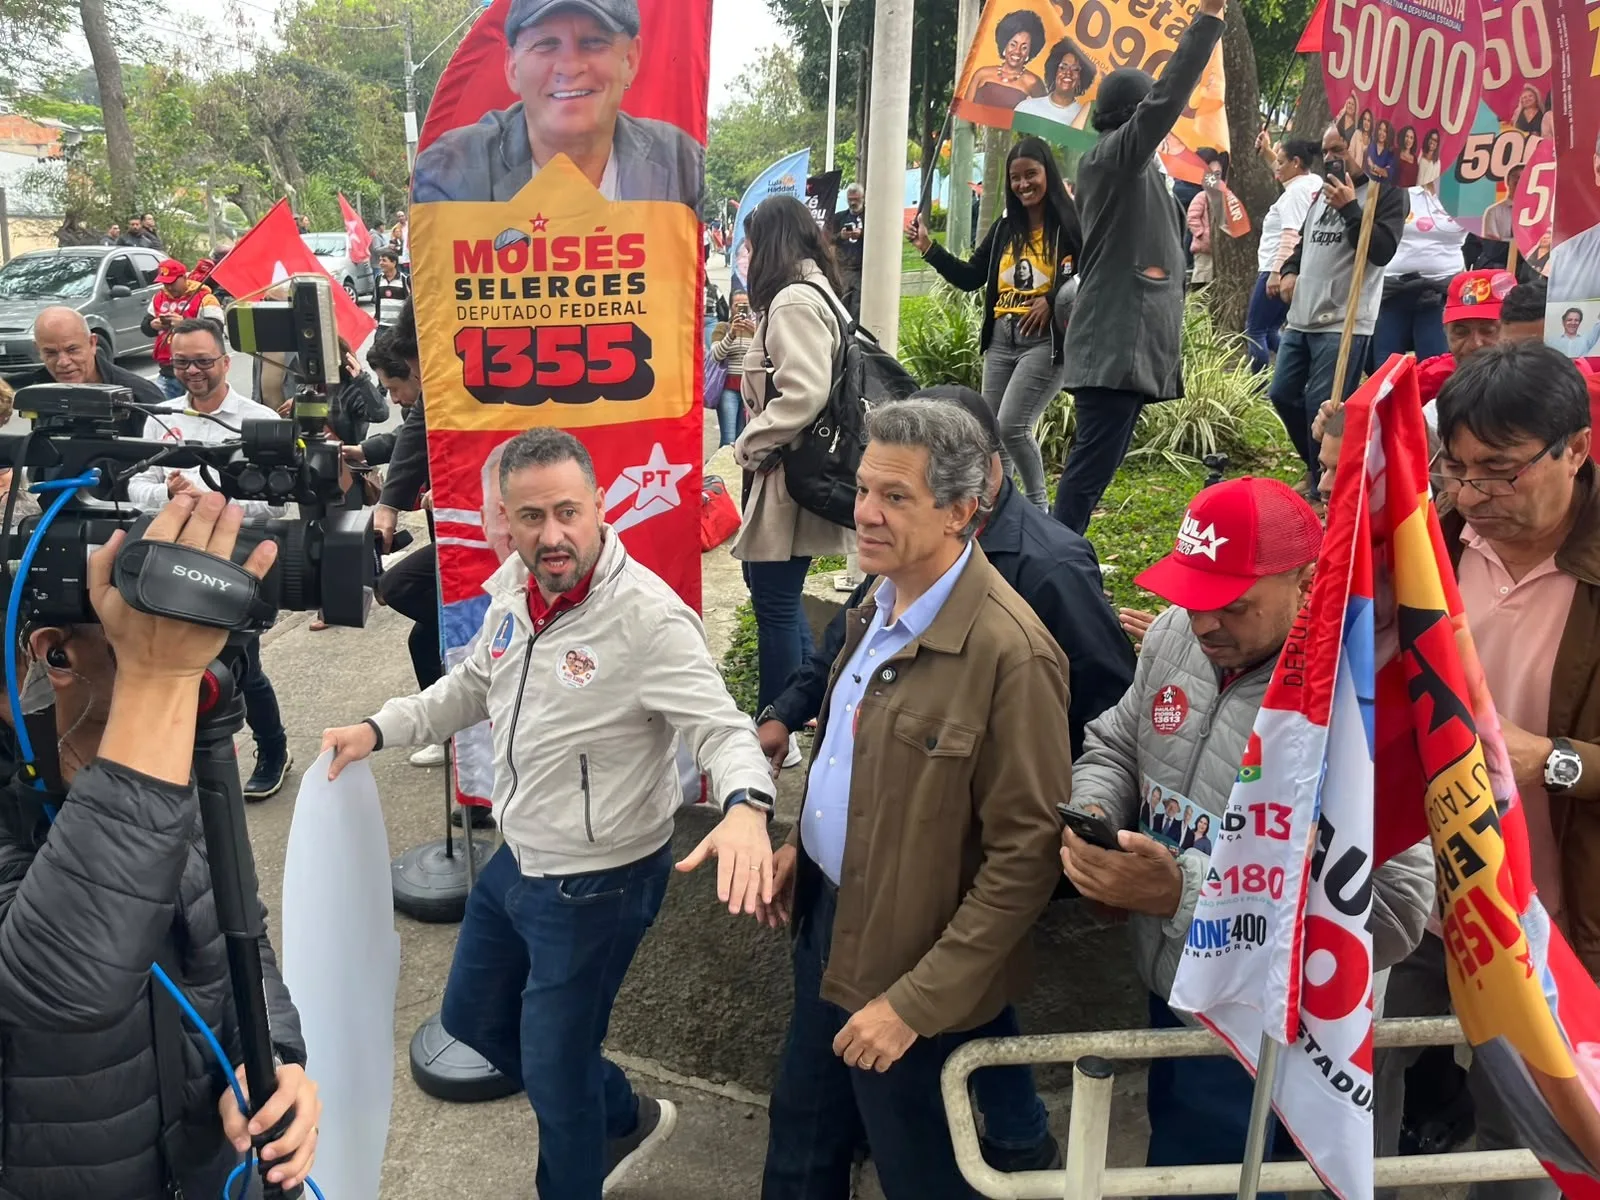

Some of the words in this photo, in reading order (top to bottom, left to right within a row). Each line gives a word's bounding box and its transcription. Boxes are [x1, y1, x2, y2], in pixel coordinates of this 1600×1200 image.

[1328, 0, 1476, 135] 50000
[453, 226, 647, 274] MOISÉS
[1309, 229, 1344, 247] Kappa
[454, 272, 646, 301] SELERGES
[457, 303, 552, 321] DEPUTADO
[559, 300, 648, 319] FEDERAL
[454, 322, 648, 398] 1355
[642, 469, 672, 489] PT
[1175, 539, 1195, 556] 2026
[172, 563, 232, 592] SONY
[1248, 802, 1292, 841] 13
[1224, 863, 1285, 900] 180
[1231, 913, 1267, 947] 400
[1297, 1017, 1373, 1113] STADU
